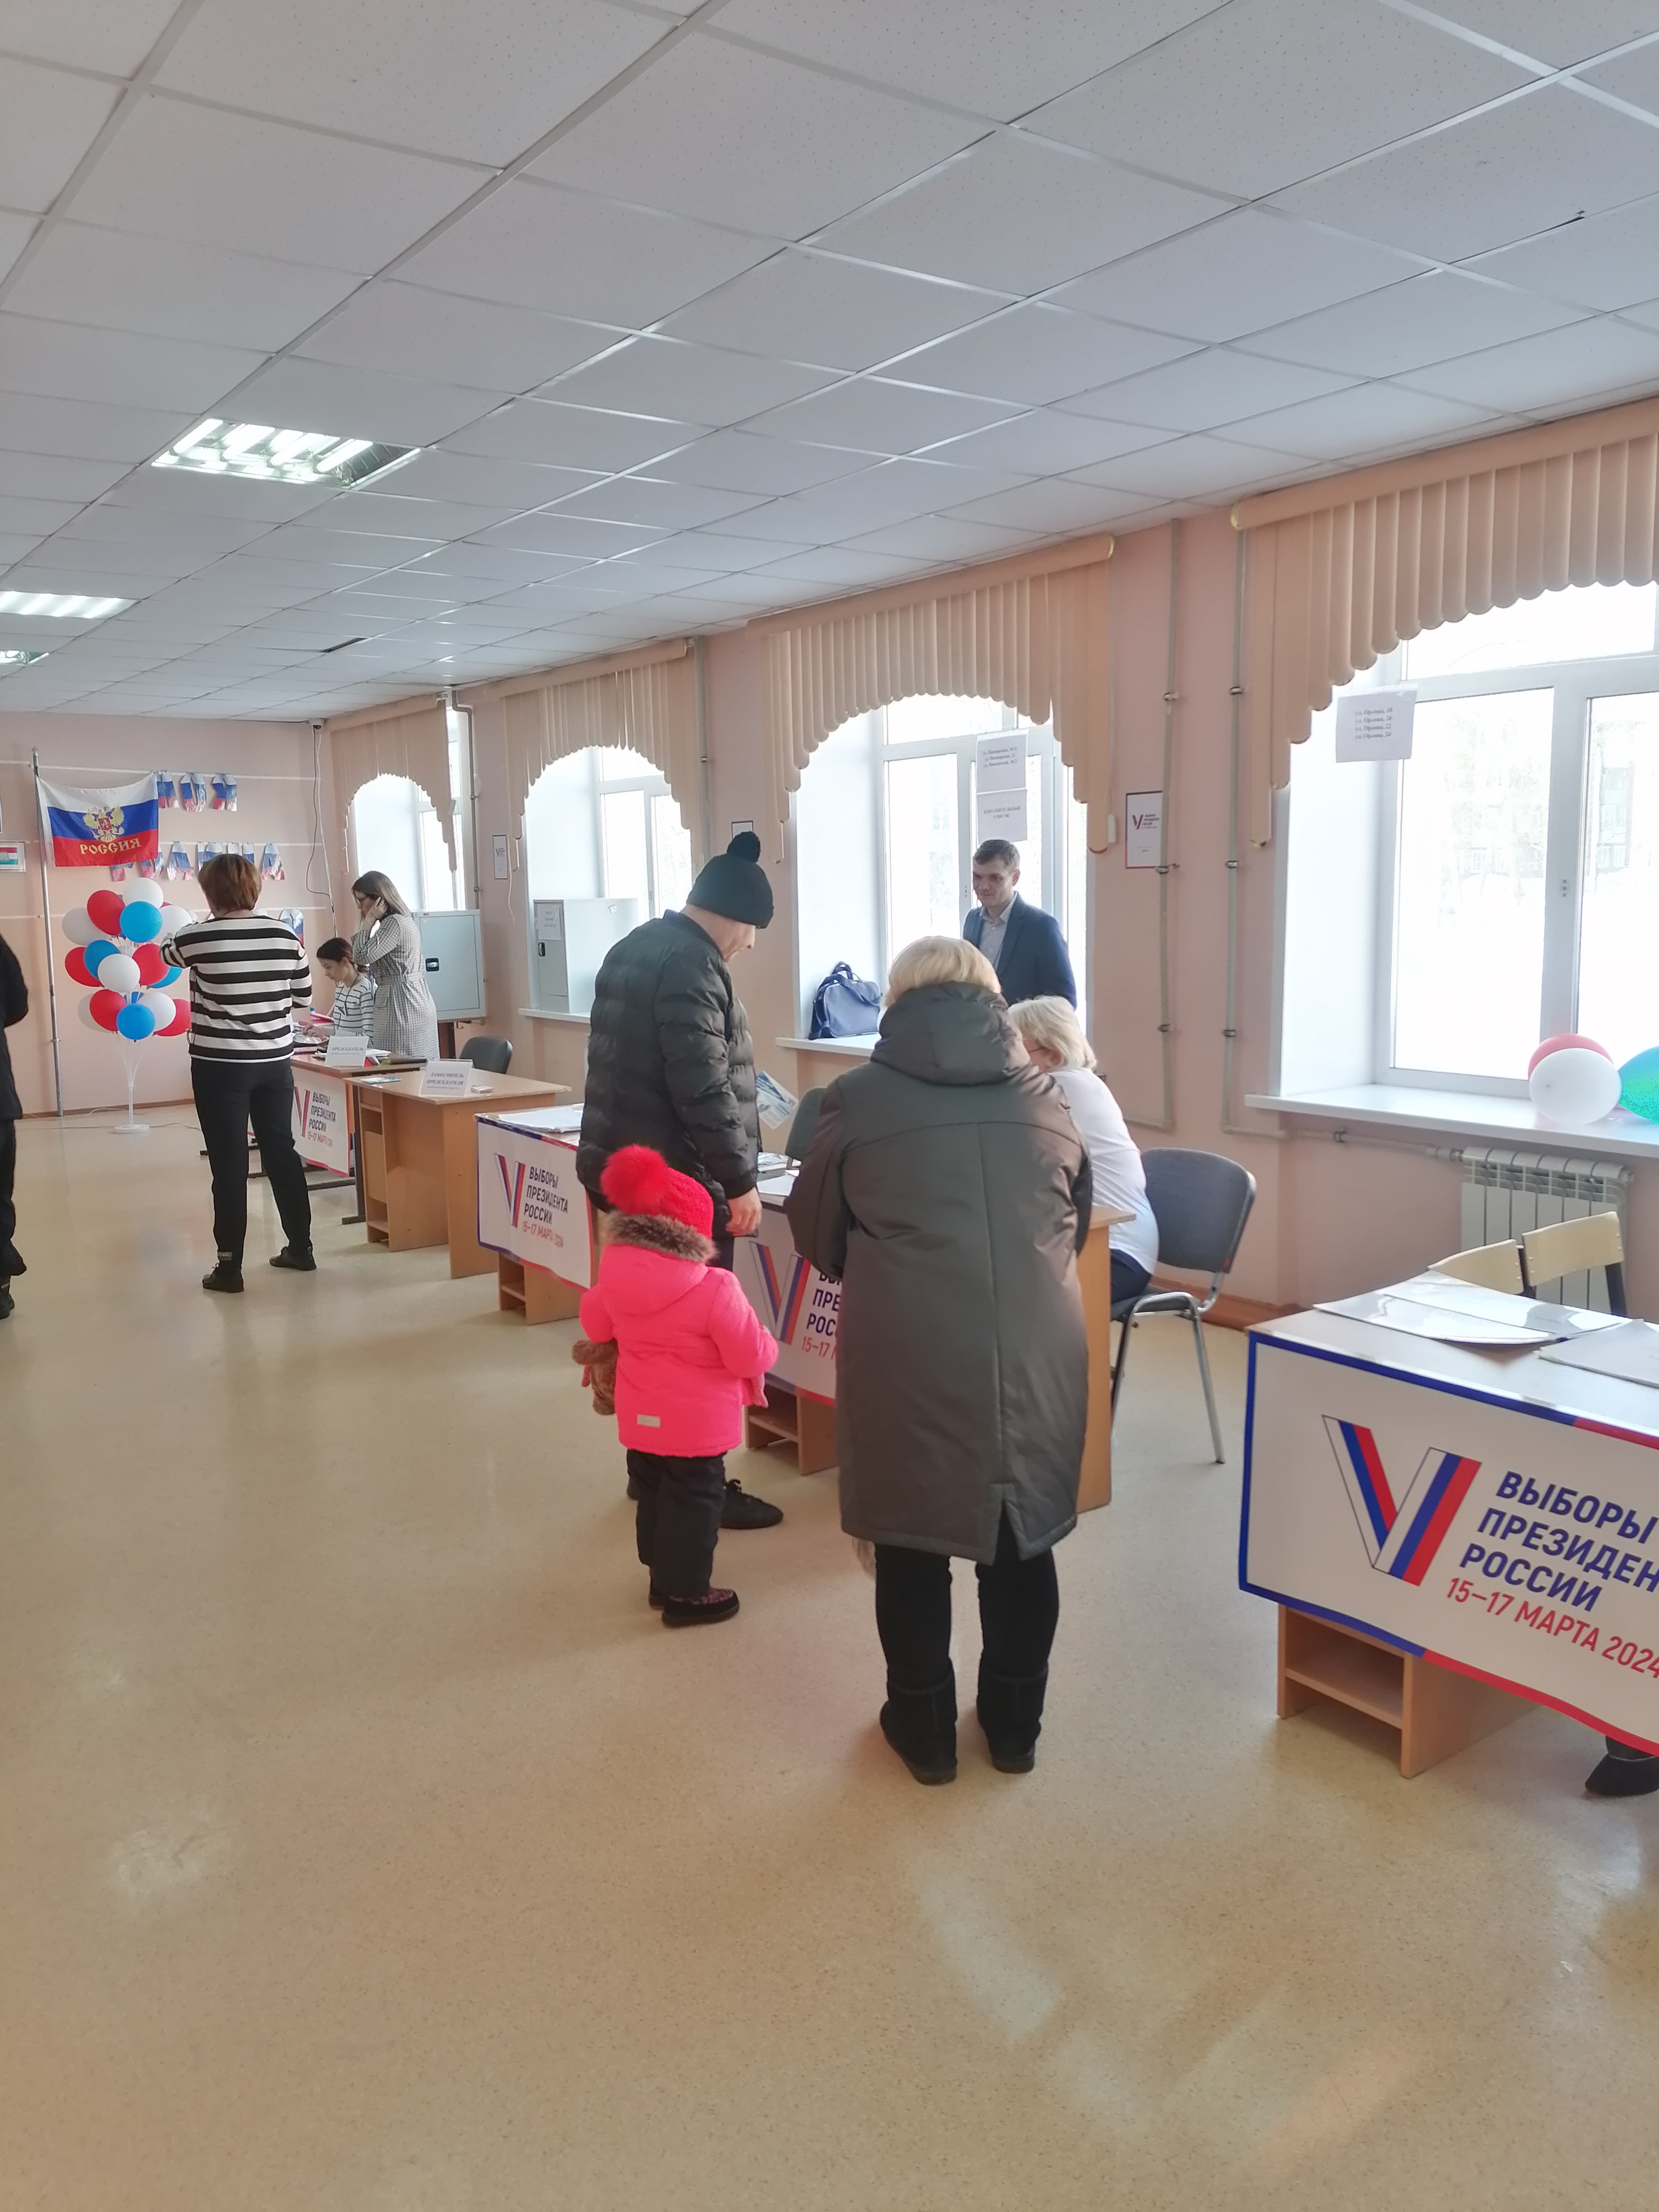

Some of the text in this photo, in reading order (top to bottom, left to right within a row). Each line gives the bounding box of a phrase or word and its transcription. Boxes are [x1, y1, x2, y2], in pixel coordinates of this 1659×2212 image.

[79, 837, 142, 855] РОССИЯ
[529, 1166, 559, 1189] ВЫБОРЫ
[524, 1202, 553, 1225] РОССИИ
[526, 1185, 568, 1214] ПРЕЗИДЕНТА
[1496, 1470, 1659, 1545] ВЫБОРЫ
[1459, 1542, 1603, 1612] РОССИИ
[1446, 1577, 1515, 1617] 15–17
[1514, 1600, 1600, 1652] МАРТА
